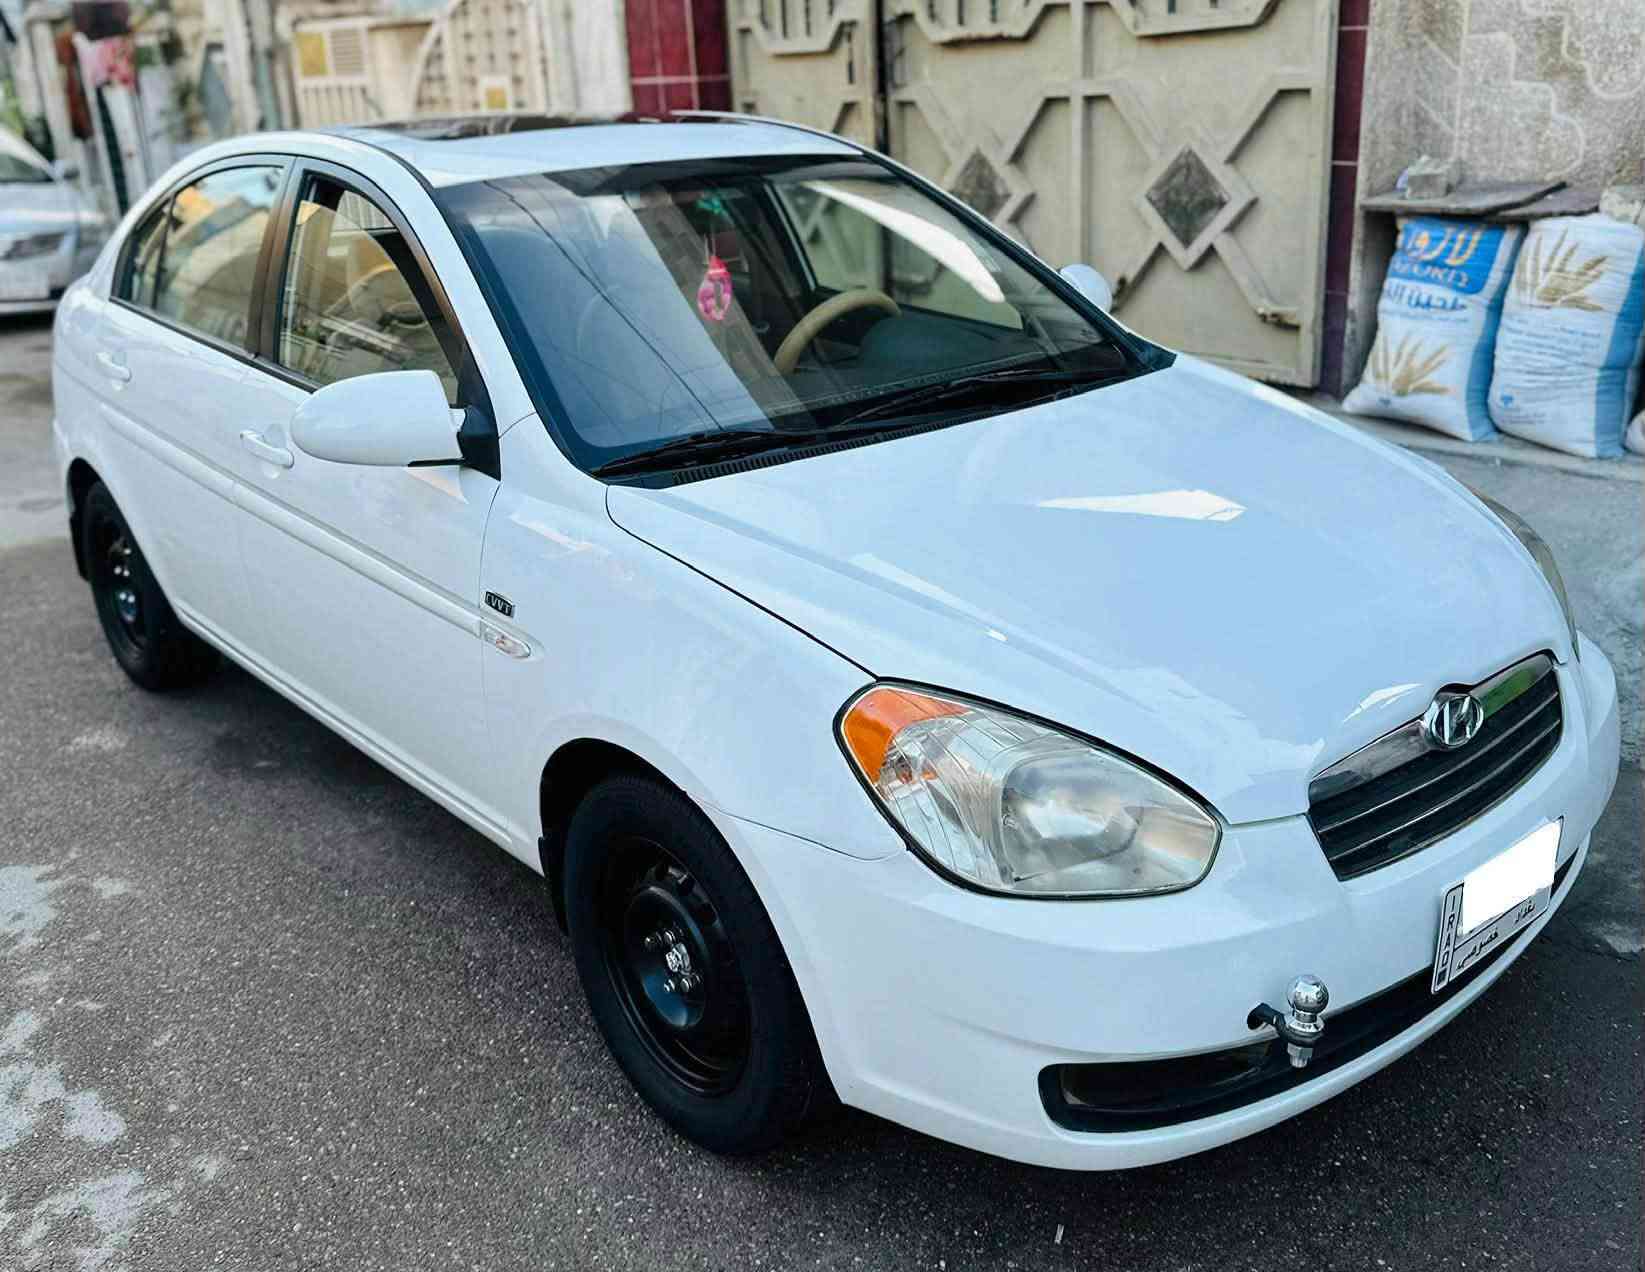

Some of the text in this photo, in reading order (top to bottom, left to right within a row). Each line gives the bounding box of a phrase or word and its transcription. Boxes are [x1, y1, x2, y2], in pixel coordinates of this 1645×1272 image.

[1441, 895, 1456, 968] IRAQ
[1456, 899, 1537, 971] بغداد خصوصي
